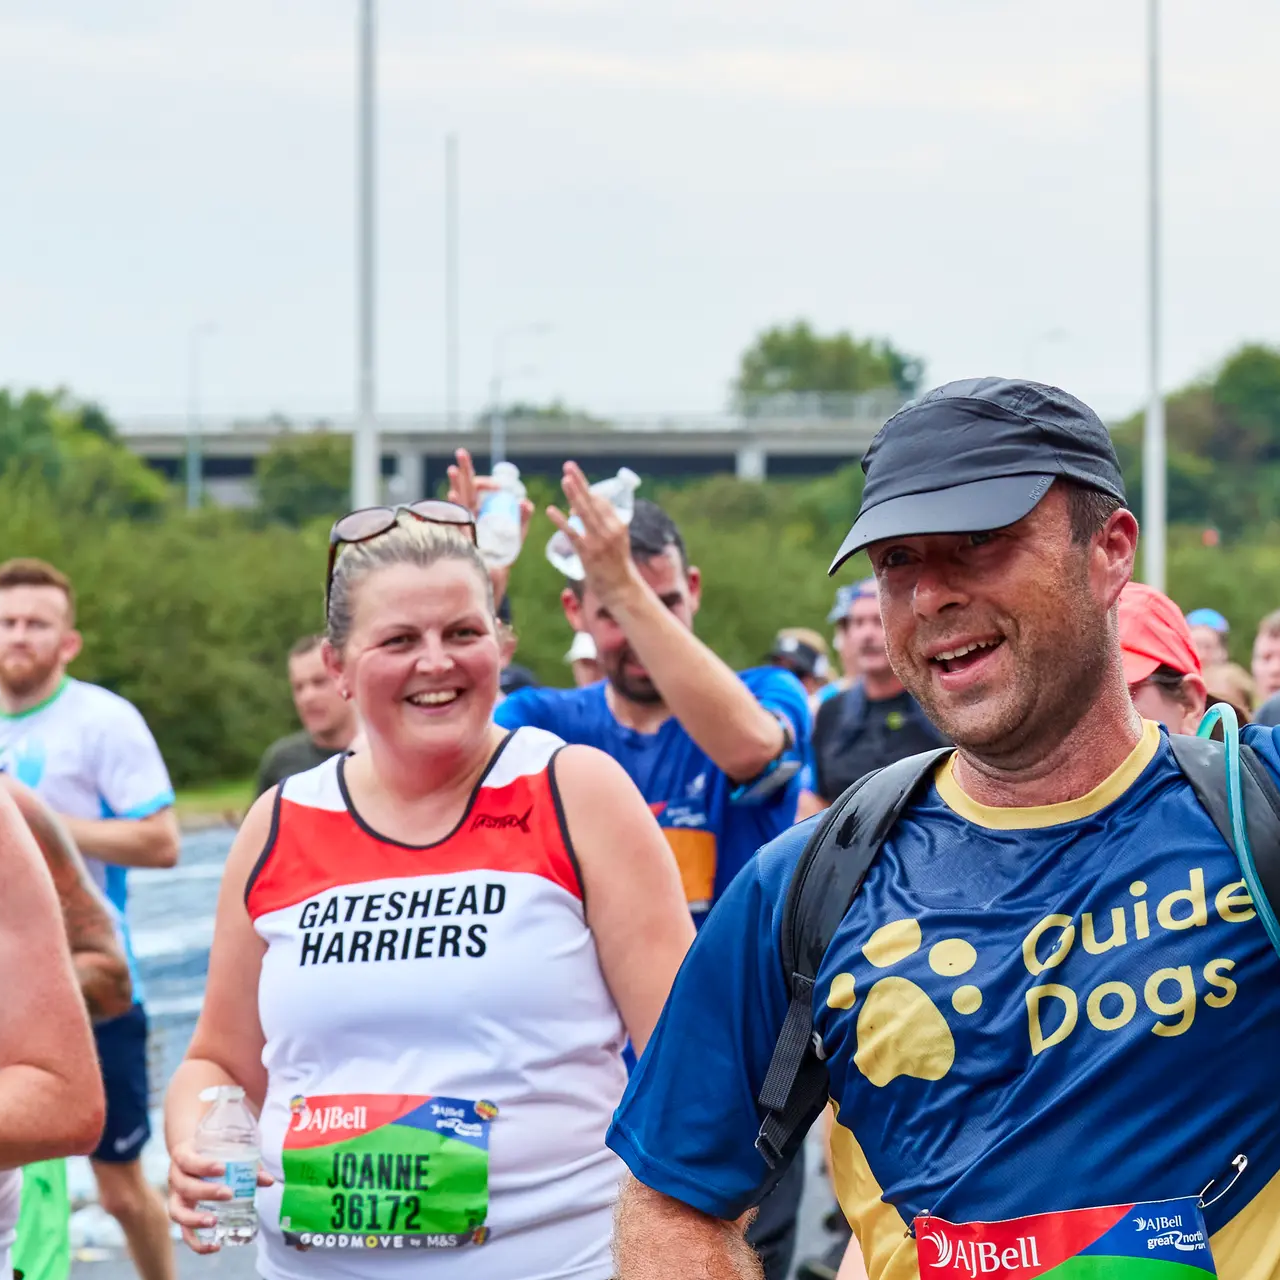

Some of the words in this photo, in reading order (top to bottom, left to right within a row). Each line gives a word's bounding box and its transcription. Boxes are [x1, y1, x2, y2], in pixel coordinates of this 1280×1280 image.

[298, 883, 506, 930] GATESHEAD
[1022, 867, 1257, 976] Guide
[299, 924, 488, 967] HARRIERS
[1025, 958, 1238, 1057] Dogs
[327, 1151, 430, 1191] JOANNE
[330, 1193, 421, 1231] 36172
[300, 1232, 404, 1248] GOODMOVE
[427, 1234, 458, 1247] M&S
[1147, 1234, 1175, 1250] great
[1182, 1230, 1204, 1243] north
